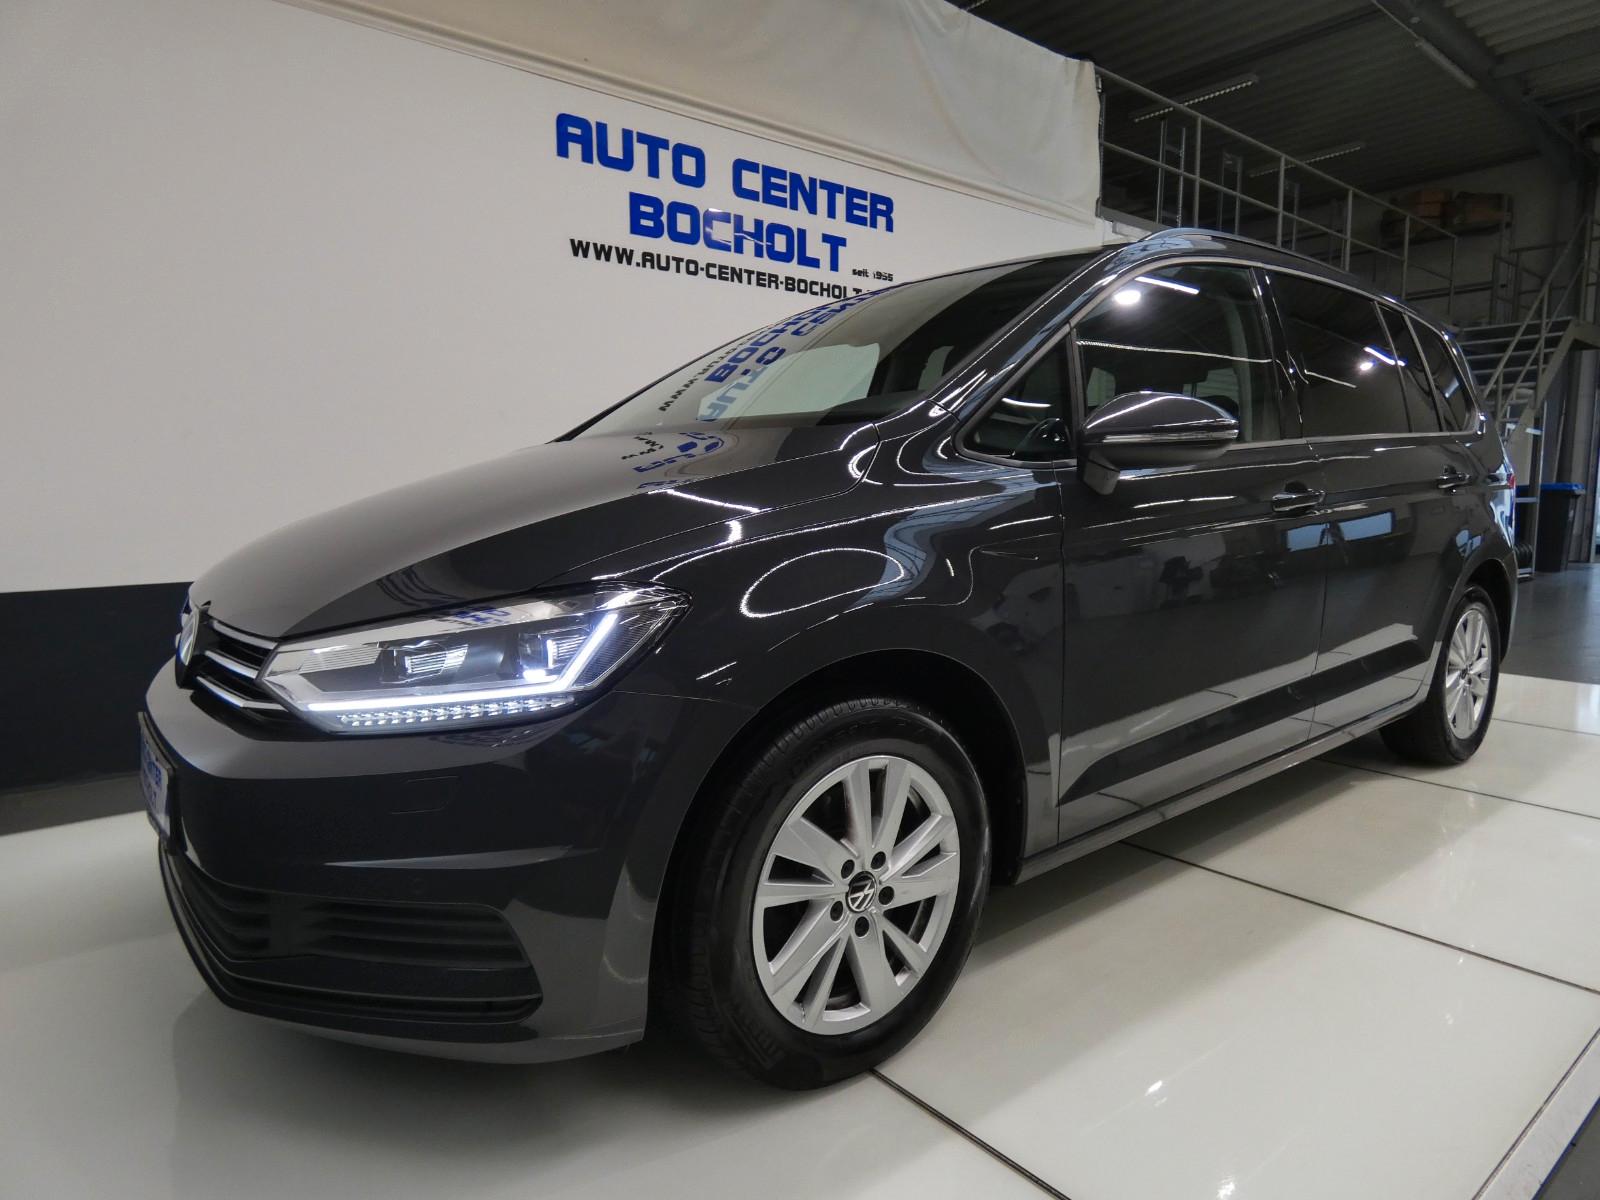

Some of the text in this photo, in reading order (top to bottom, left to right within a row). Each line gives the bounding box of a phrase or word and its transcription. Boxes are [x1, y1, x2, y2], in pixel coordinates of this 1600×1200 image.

[556, 113, 894, 233] AUTO CENTER
[629, 192, 847, 272] BOCHOLT
